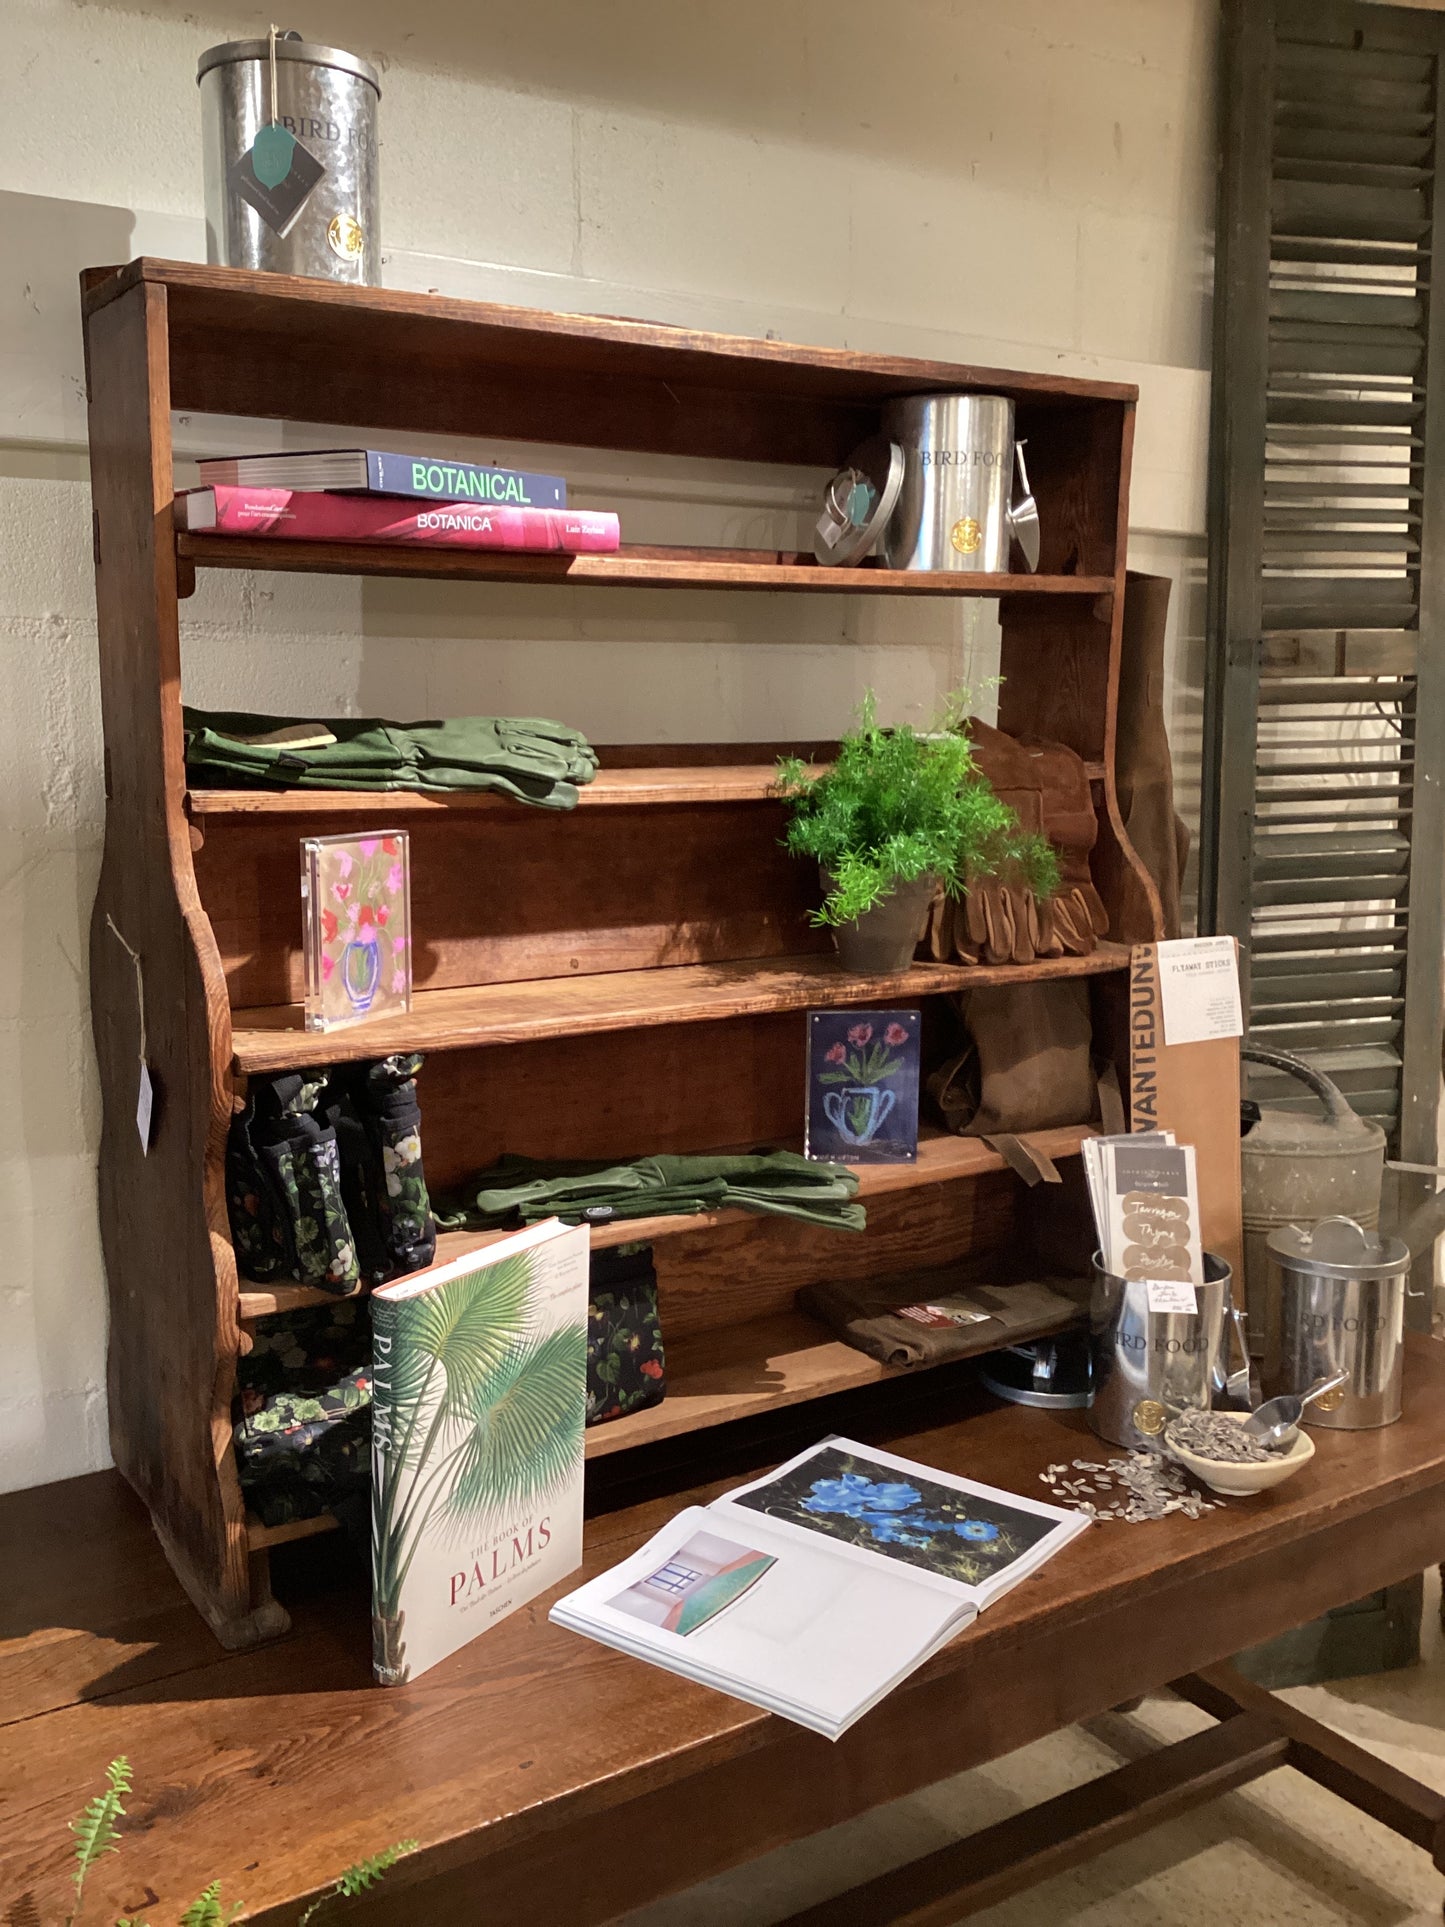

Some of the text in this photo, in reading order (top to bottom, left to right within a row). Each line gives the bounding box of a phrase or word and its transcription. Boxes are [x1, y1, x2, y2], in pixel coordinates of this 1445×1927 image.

[281, 116, 340, 141] BIRD
[921, 450, 967, 466] BIRD
[412, 463, 531, 503] BOTANICAL
[417, 513, 492, 531] BOTANICA
[1155, 1338, 1209, 1353] FOOD
[374, 1333, 393, 1452] PALMS
[471, 1514, 534, 1559] THE BOOK OF
[450, 1516, 551, 1607] PALMS
